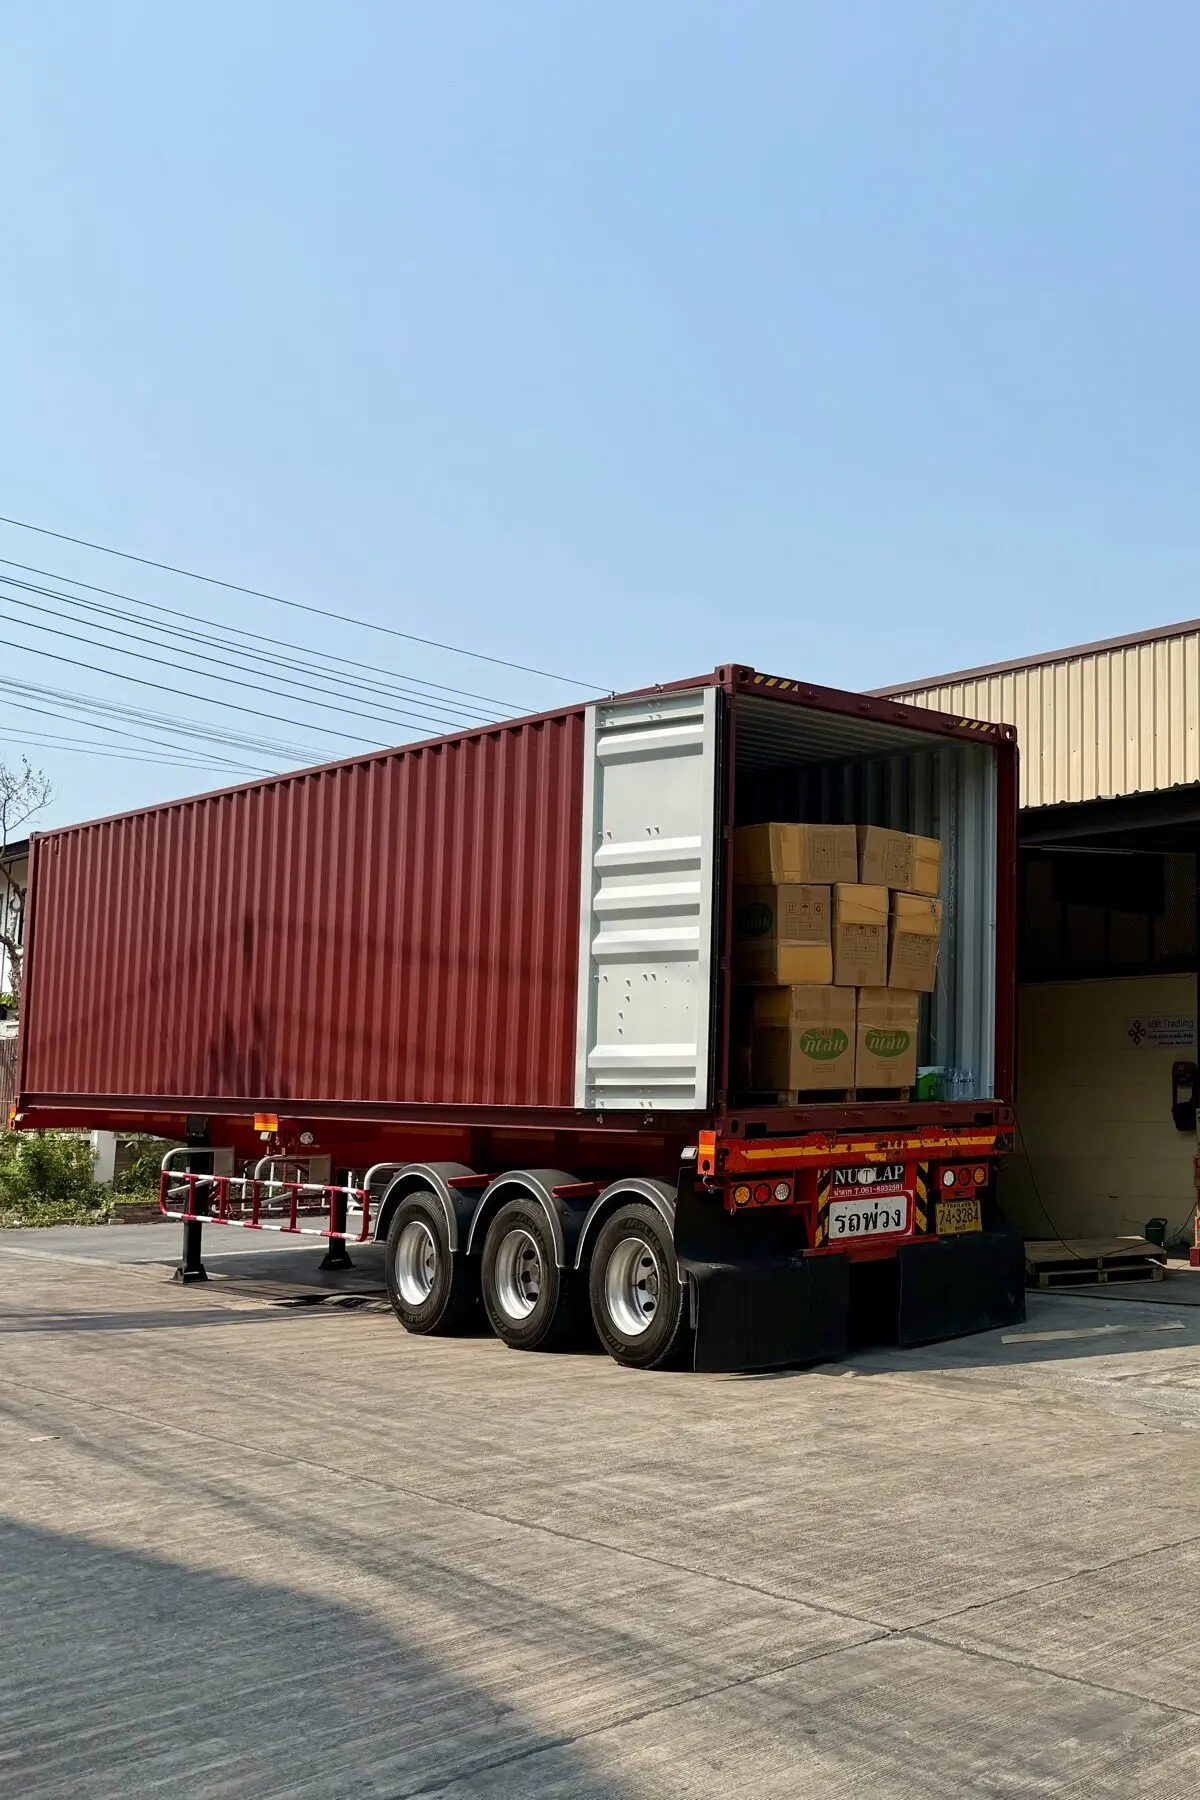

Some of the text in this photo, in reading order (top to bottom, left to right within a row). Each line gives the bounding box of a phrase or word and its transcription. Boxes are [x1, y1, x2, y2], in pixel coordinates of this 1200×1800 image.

[834, 1166, 904, 1185] NUTLAP
[834, 1203, 900, 1234] รถพ่วง
[939, 1207, 978, 1225] 74-3264
